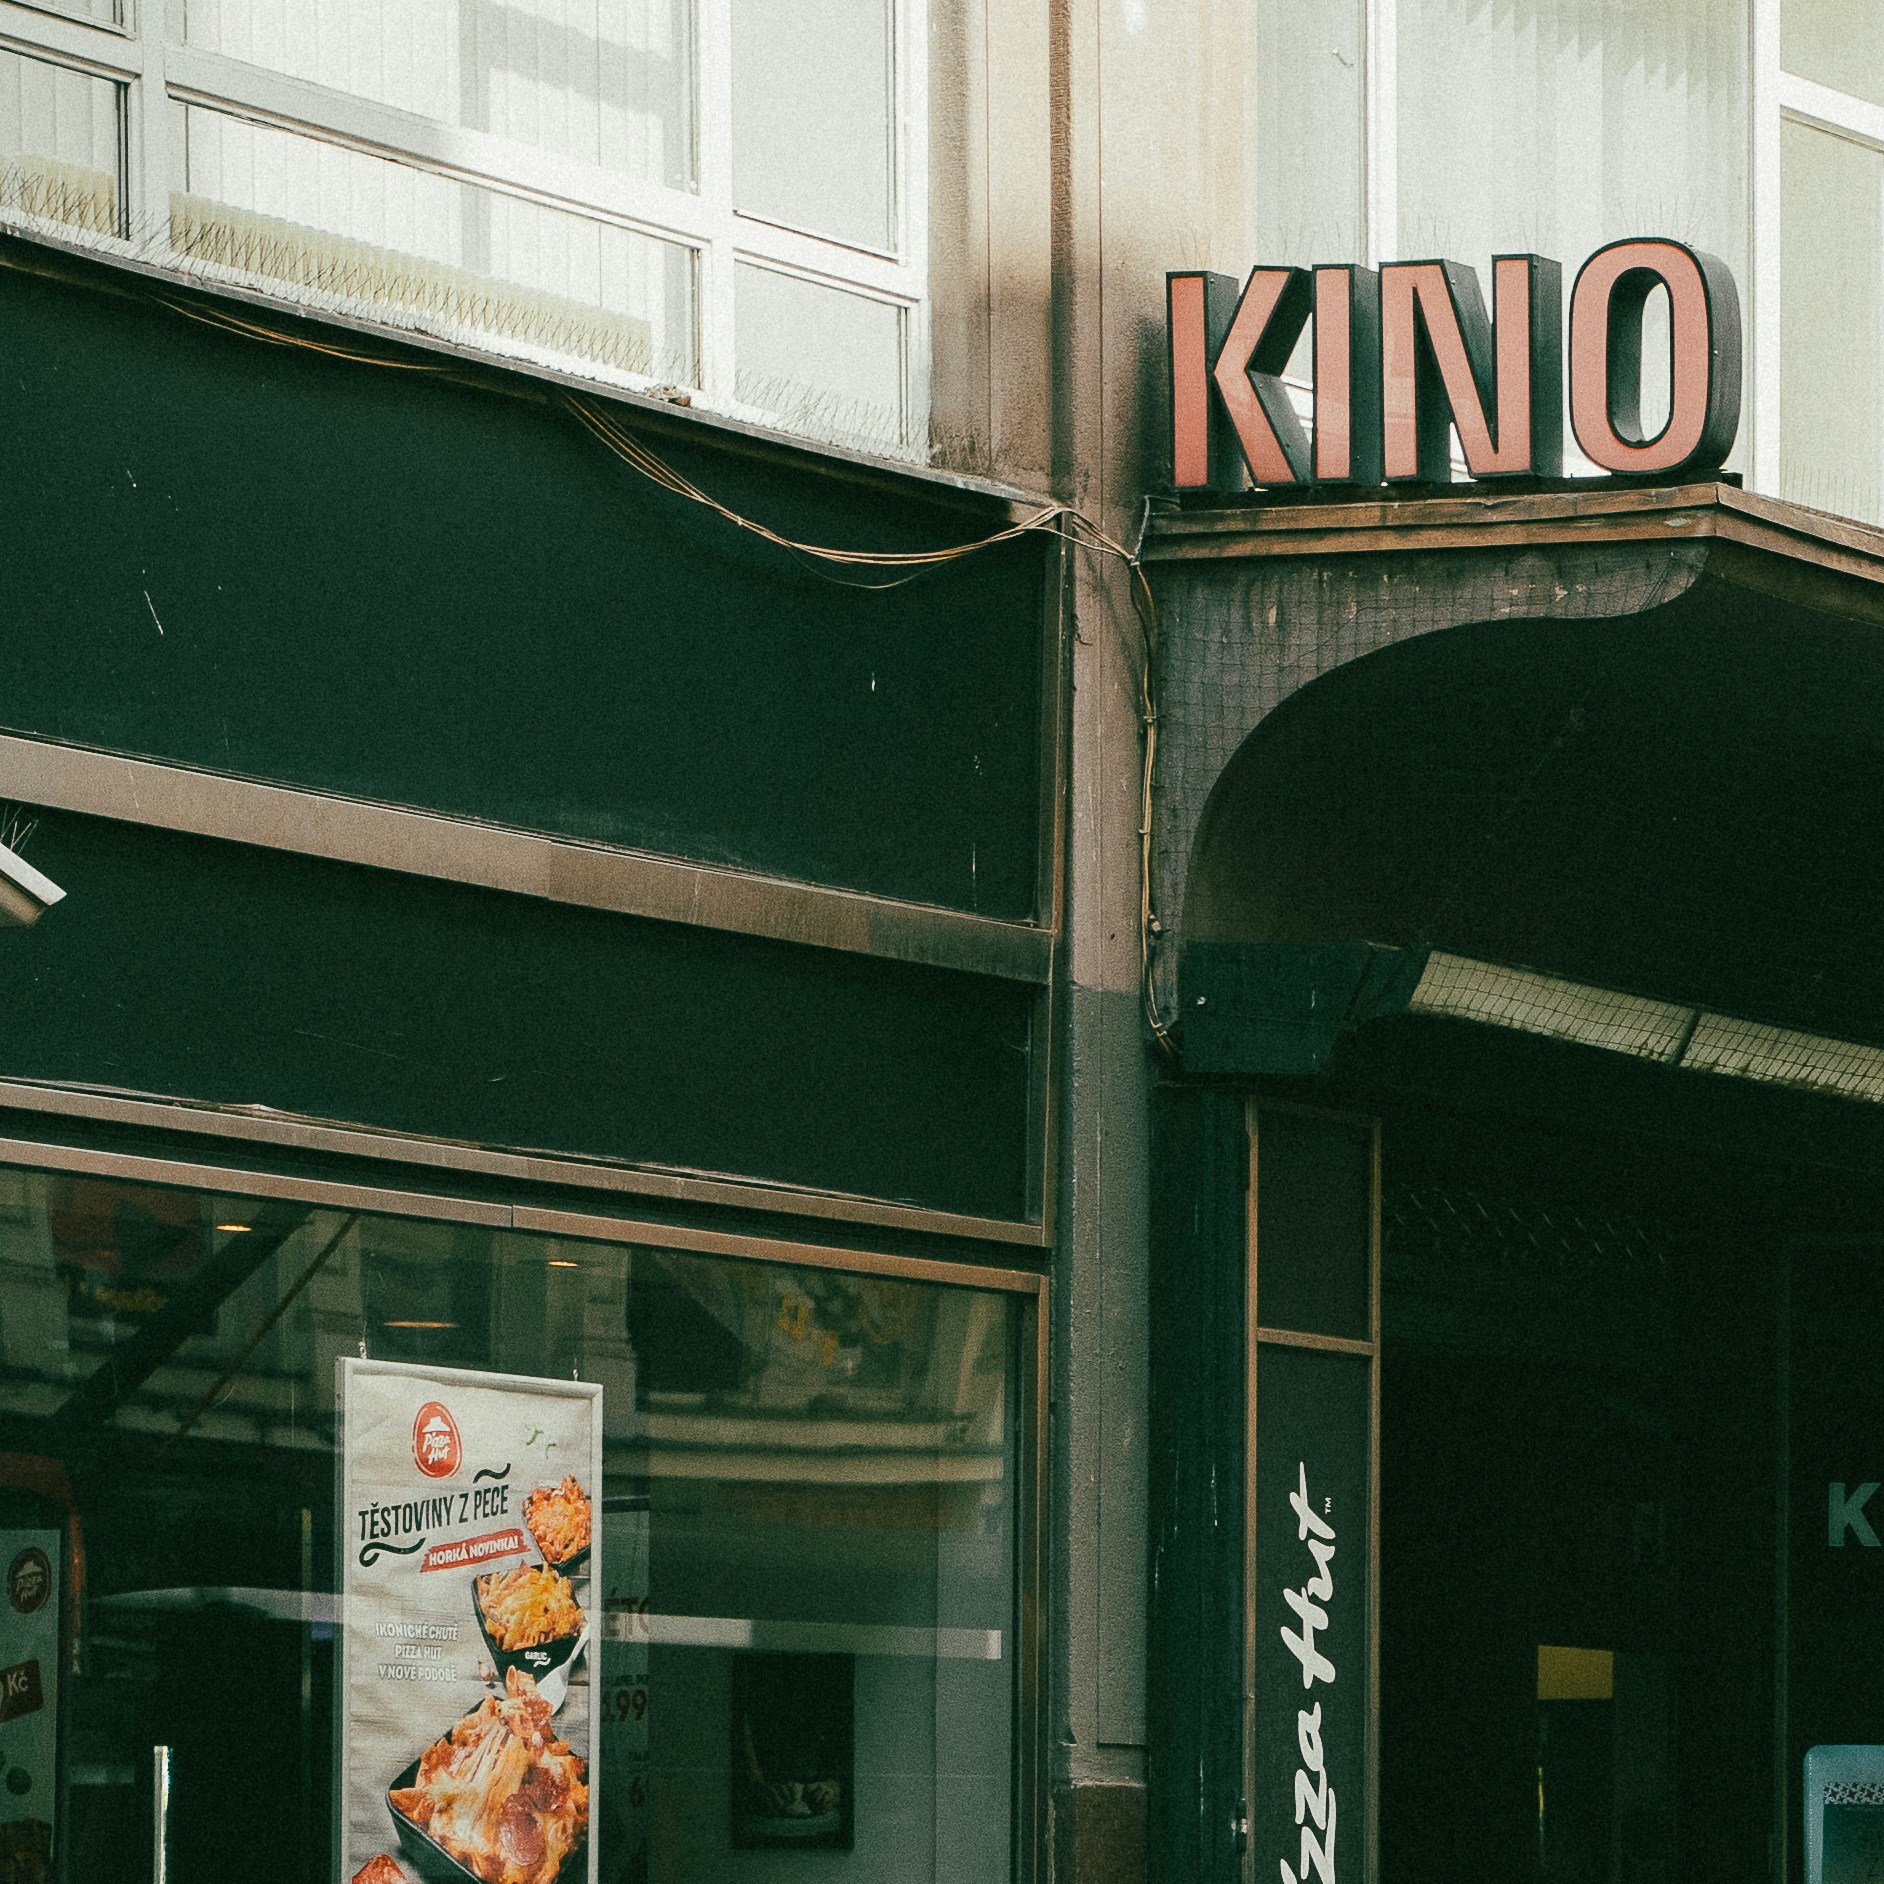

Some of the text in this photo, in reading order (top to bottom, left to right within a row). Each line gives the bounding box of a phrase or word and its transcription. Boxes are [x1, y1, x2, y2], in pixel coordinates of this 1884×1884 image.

[1166, 236, 1742, 489] KINO
[358, 1492, 456, 1542] TĚSTOVINY
[459, 1492, 469, 1524] Z
[427, 1534, 520, 1567] HORKÁ NOVINKA!
[1279, 1461, 1338, 1689] Hut
[394, 1644, 443, 1661] PIZZA HUT
[6, 1668, 29, 1699] Kč
